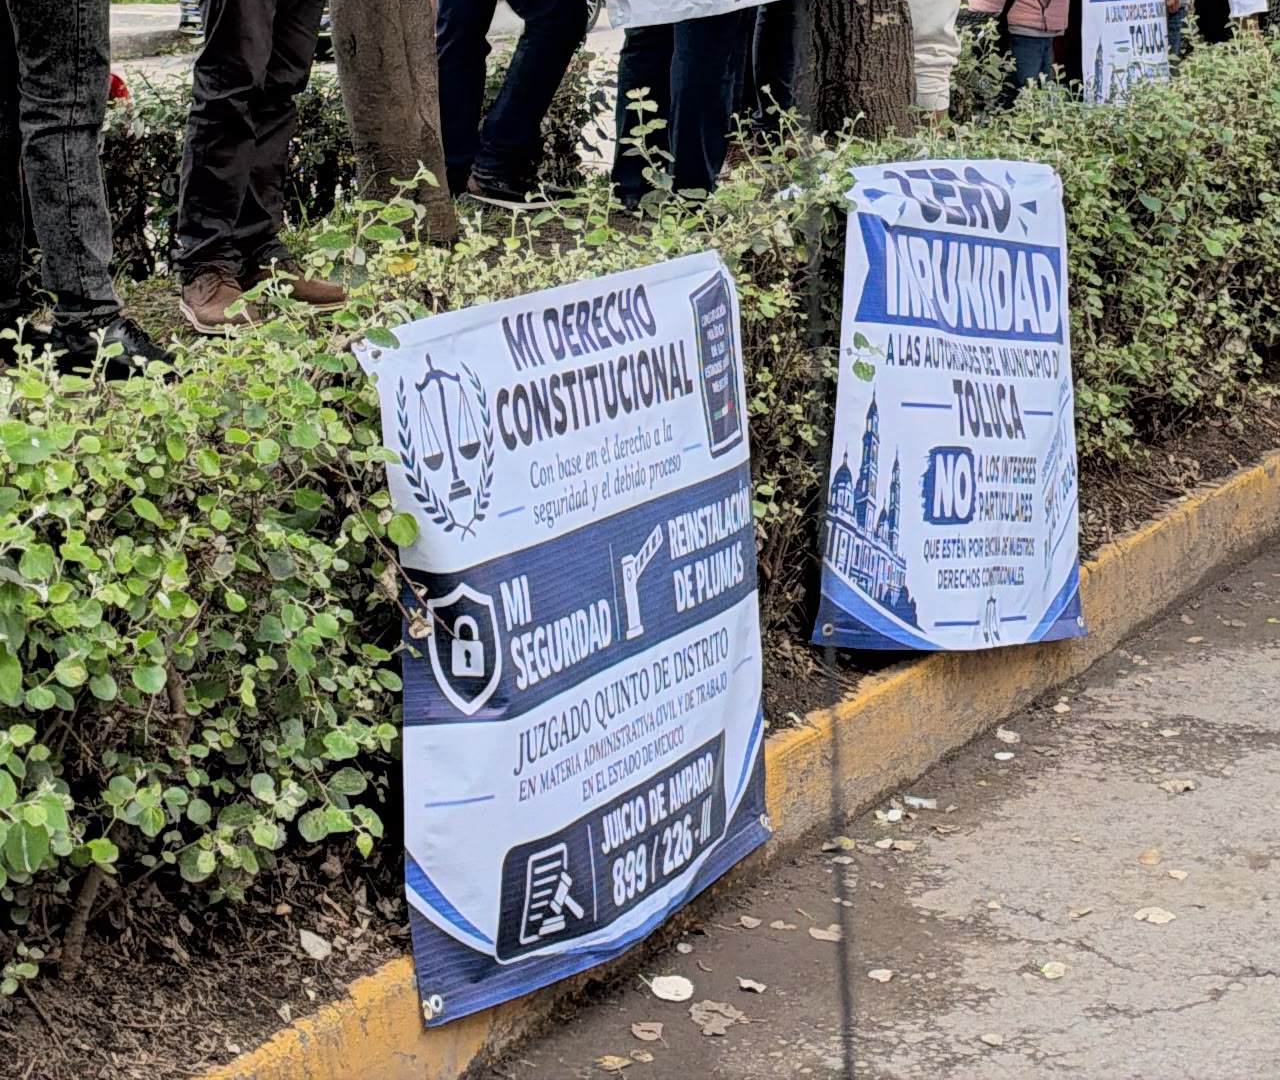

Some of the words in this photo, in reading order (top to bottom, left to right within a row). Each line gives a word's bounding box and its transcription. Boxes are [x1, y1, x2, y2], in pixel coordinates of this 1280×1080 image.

[501, 311, 545, 372] MI
[545, 283, 658, 362] DERECHO
[886, 333, 895, 366] A
[899, 333, 921, 367] LAS
[979, 345, 1001, 377] DEL
[998, 346, 1052, 378] MUNICIPIO
[496, 339, 694, 452] CONSTITUCIONAL
[952, 378, 1026, 440] TOLUCA
[530, 456, 555, 490] Con
[556, 448, 583, 481] base
[585, 452, 598, 474] en
[600, 439, 612, 468] el
[613, 426, 652, 464] derecho
[654, 430, 662, 450] a
[662, 419, 673, 445] la
[933, 452, 972, 519] NO
[978, 456, 983, 481] A
[985, 455, 1000, 482] LOS
[1001, 456, 1036, 485] INTERESES
[533, 479, 589, 530] seguridad
[590, 484, 600, 514] y
[601, 473, 612, 502] el
[613, 461, 647, 499] debido
[648, 454, 682, 495] proceso
[667, 480, 750, 560] REINSTALACIÓN
[978, 491, 1032, 523] PARTICULARES
[673, 565, 693, 613] DE
[694, 541, 744, 608] PLUMAS
[923, 538, 940, 564] QUE
[942, 532, 966, 560] ESTÉN
[968, 537, 983, 558] POR
[937, 568, 980, 590] DERECHOS
[500, 575, 532, 632] MI
[510, 599, 613, 690] SEGURIDAD
[513, 698, 591, 777] JUZGADO
[594, 671, 650, 732] QUINTO
[653, 659, 671, 695] DE
[672, 626, 729, 685] DISTRITO
[519, 778, 536, 802] EN
[539, 754, 582, 796] MATERIA
[582, 711, 655, 768] ADMINISTRATIVA
[684, 690, 695, 711] DE
[696, 673, 728, 706] TRABAJO
[581, 779, 595, 802] EN
[595, 770, 608, 795] EL
[608, 751, 641, 790] ESTADO
[642, 745, 654, 772] DE
[653, 723, 685, 765] MÉXICO
[601, 795, 647, 855] JUICIO
[648, 782, 668, 826] DE
[669, 752, 714, 815] AMPARO
[612, 842, 648, 907] 899
